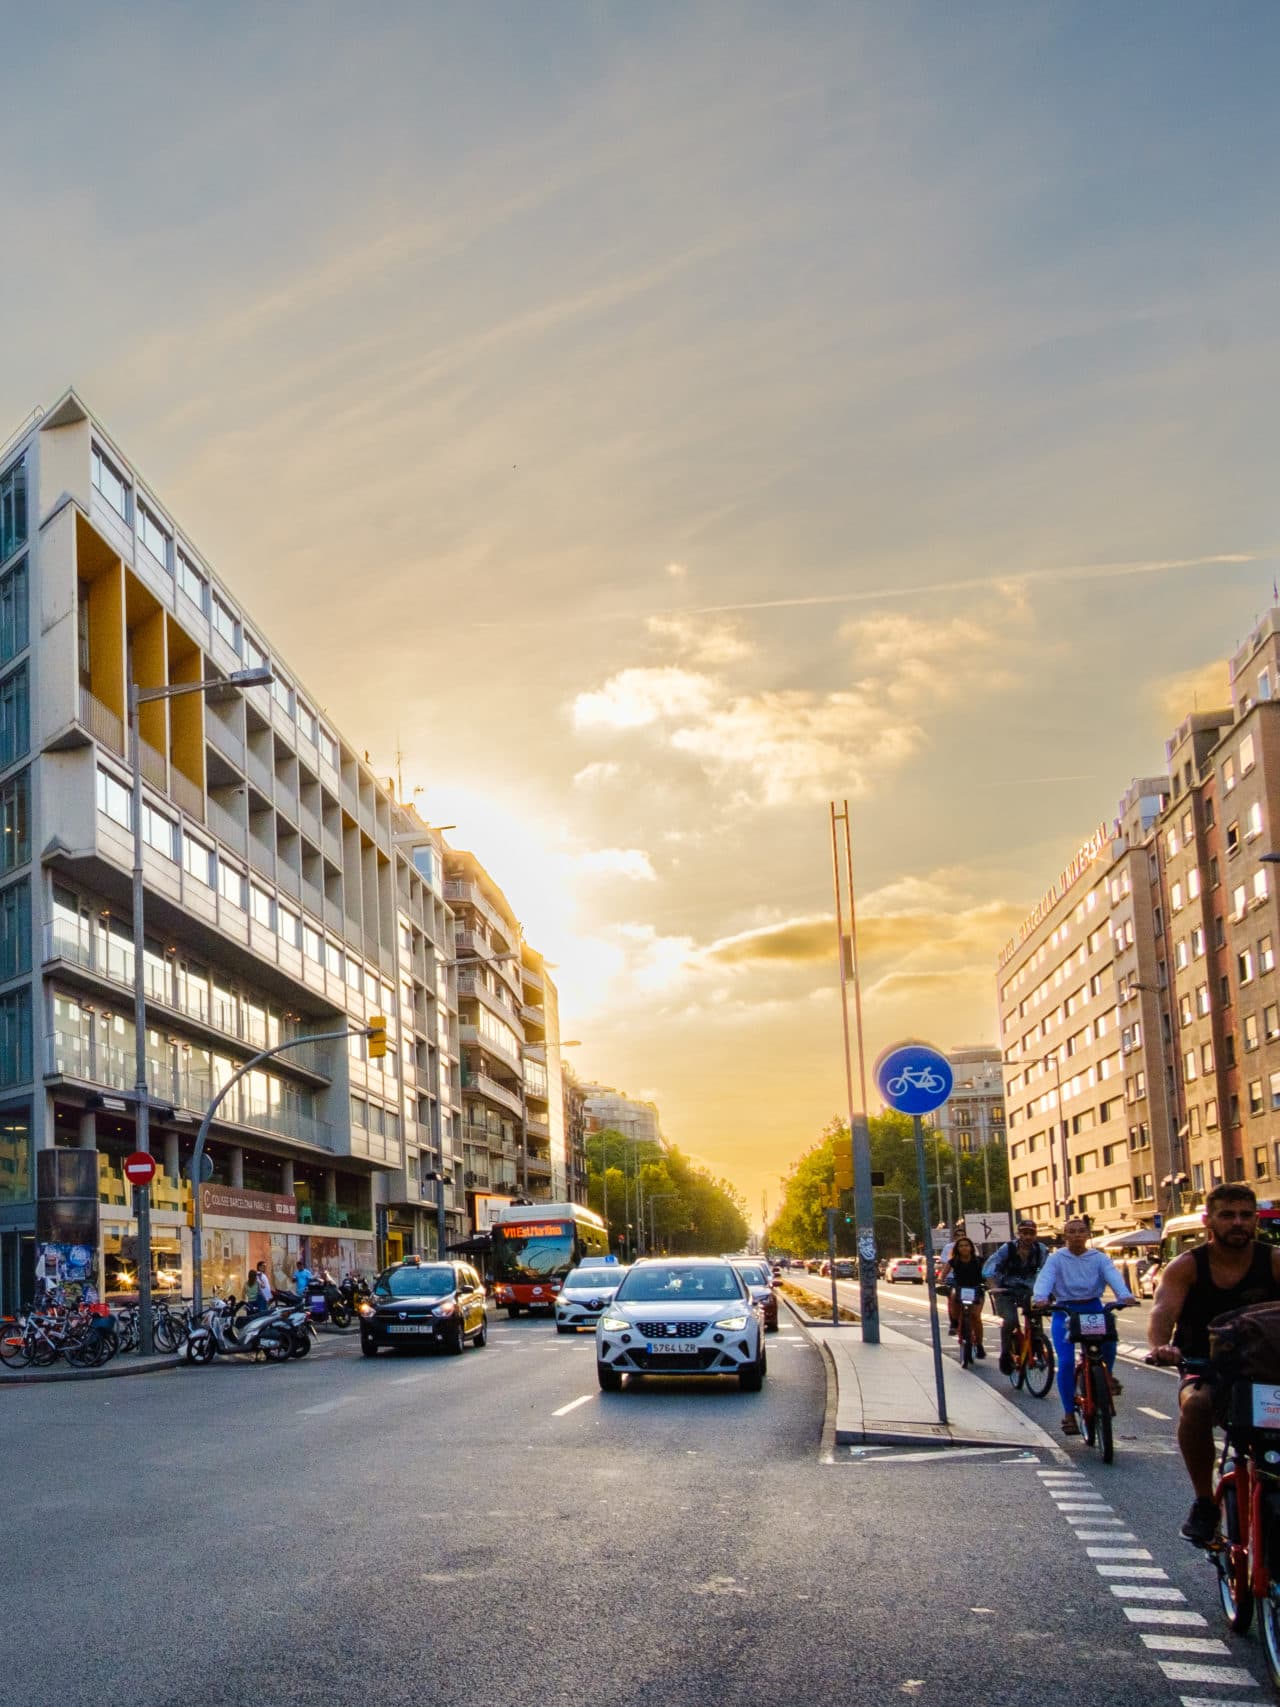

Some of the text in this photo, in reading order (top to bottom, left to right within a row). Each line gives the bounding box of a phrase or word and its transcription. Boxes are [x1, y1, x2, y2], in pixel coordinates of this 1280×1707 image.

[1059, 821, 1108, 895] UNIVERSAL
[503, 1227, 517, 1238] V11
[653, 1343, 696, 1353] 5764 LZR
